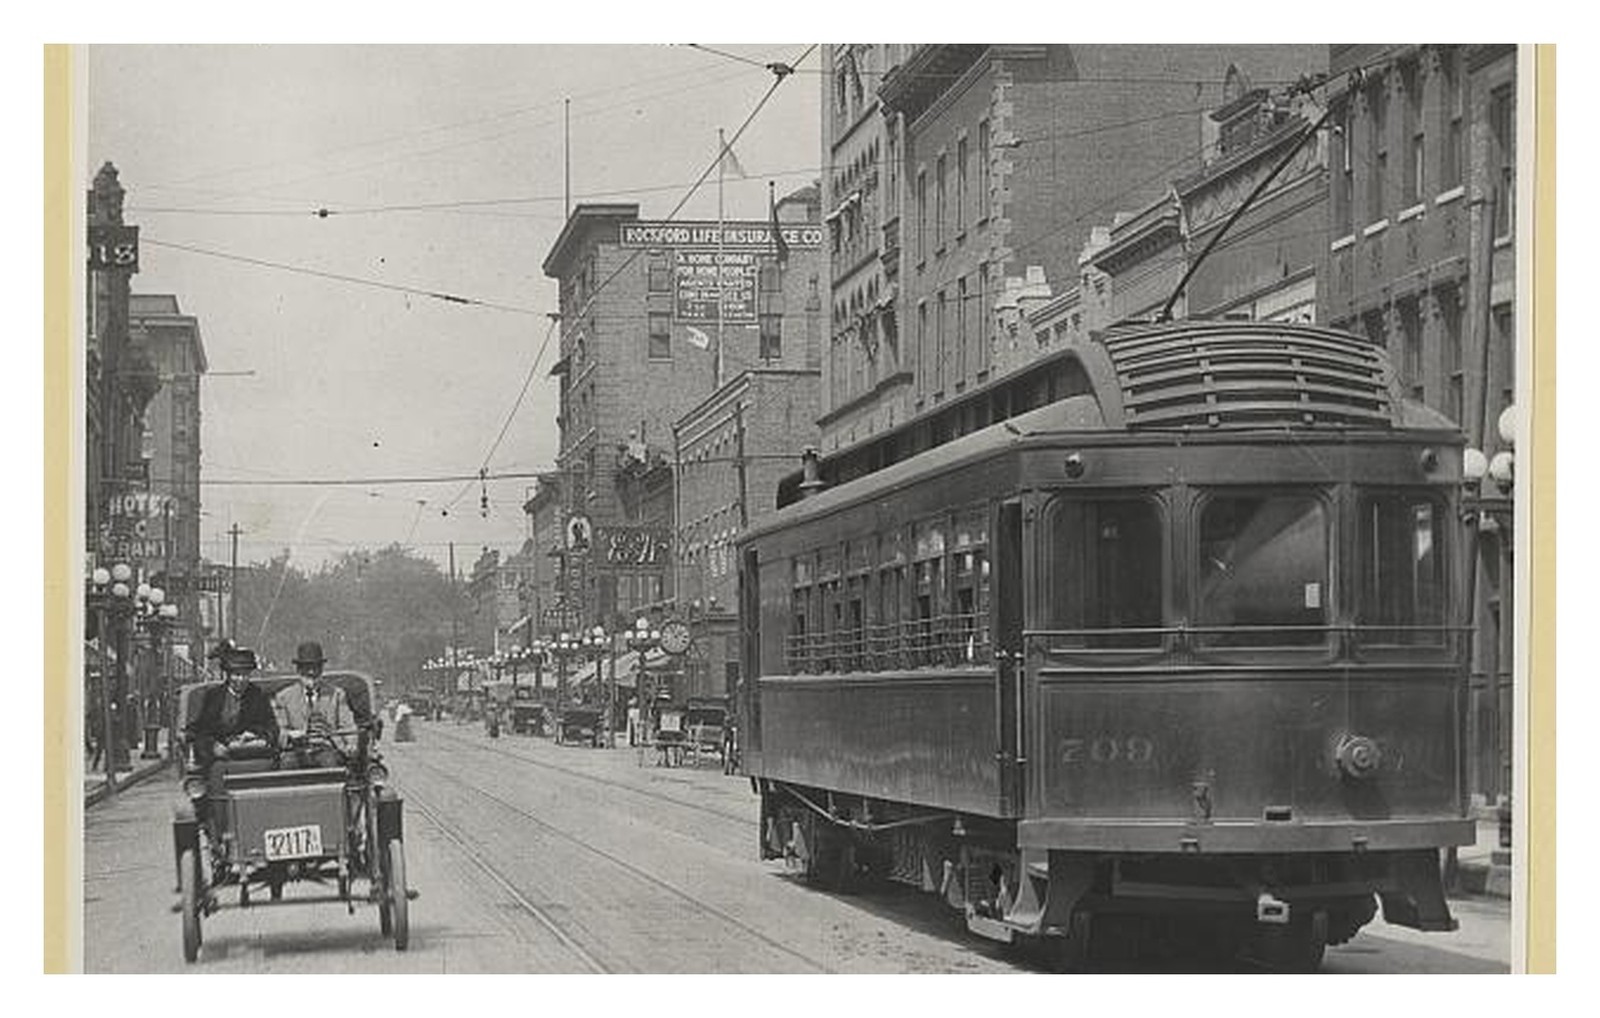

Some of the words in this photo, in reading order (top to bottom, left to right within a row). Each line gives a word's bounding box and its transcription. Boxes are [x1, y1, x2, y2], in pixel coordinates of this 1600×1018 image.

[625, 227, 690, 243] ROCKFORD
[692, 228, 721, 243] LIFE
[723, 228, 798, 243] INSURACE
